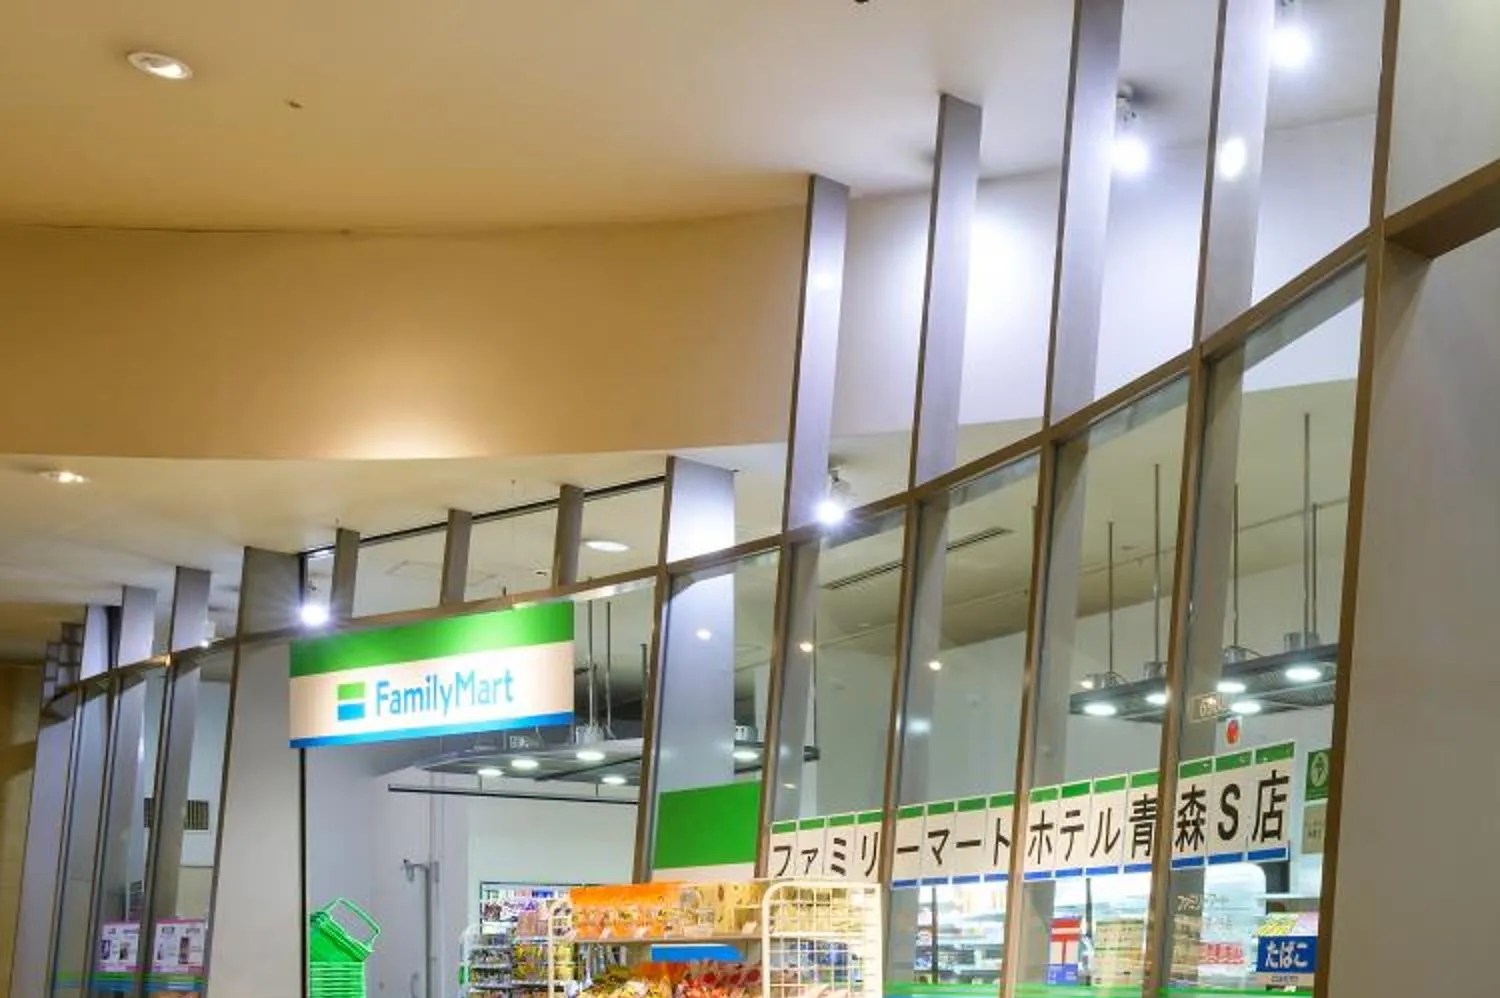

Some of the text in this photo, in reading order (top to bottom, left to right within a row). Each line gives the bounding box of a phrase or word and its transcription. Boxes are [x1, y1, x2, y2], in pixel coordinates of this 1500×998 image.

[376, 669, 514, 716] FamilyMart
[1265, 940, 1309, 969] たばこ
